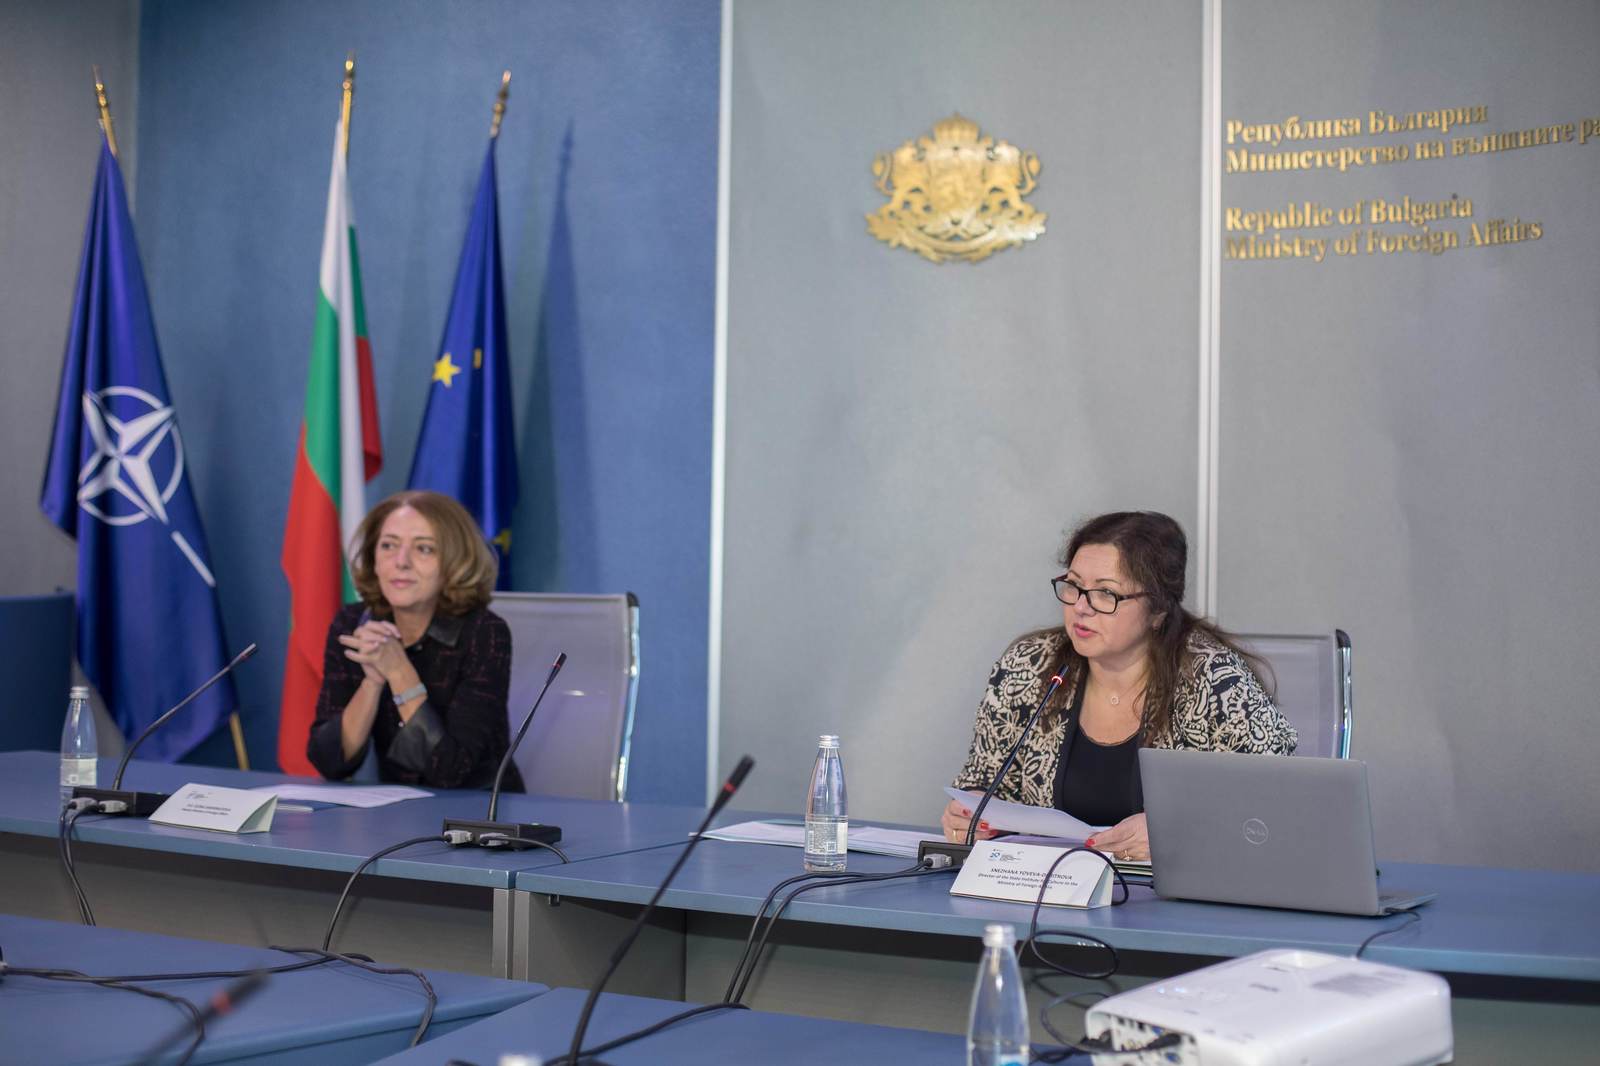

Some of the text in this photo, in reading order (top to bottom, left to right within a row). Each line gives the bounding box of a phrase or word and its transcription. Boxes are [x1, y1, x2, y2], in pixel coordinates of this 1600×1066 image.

[1226, 105, 1488, 147] Република България
[1226, 145, 1409, 173] Министерство
[1415, 141, 1445, 160] на
[1452, 122, 1575, 156] външните
[1226, 194, 1473, 234] Republic of Bulgaria
[1225, 217, 1544, 263] Ministry of Foreign Affairs
